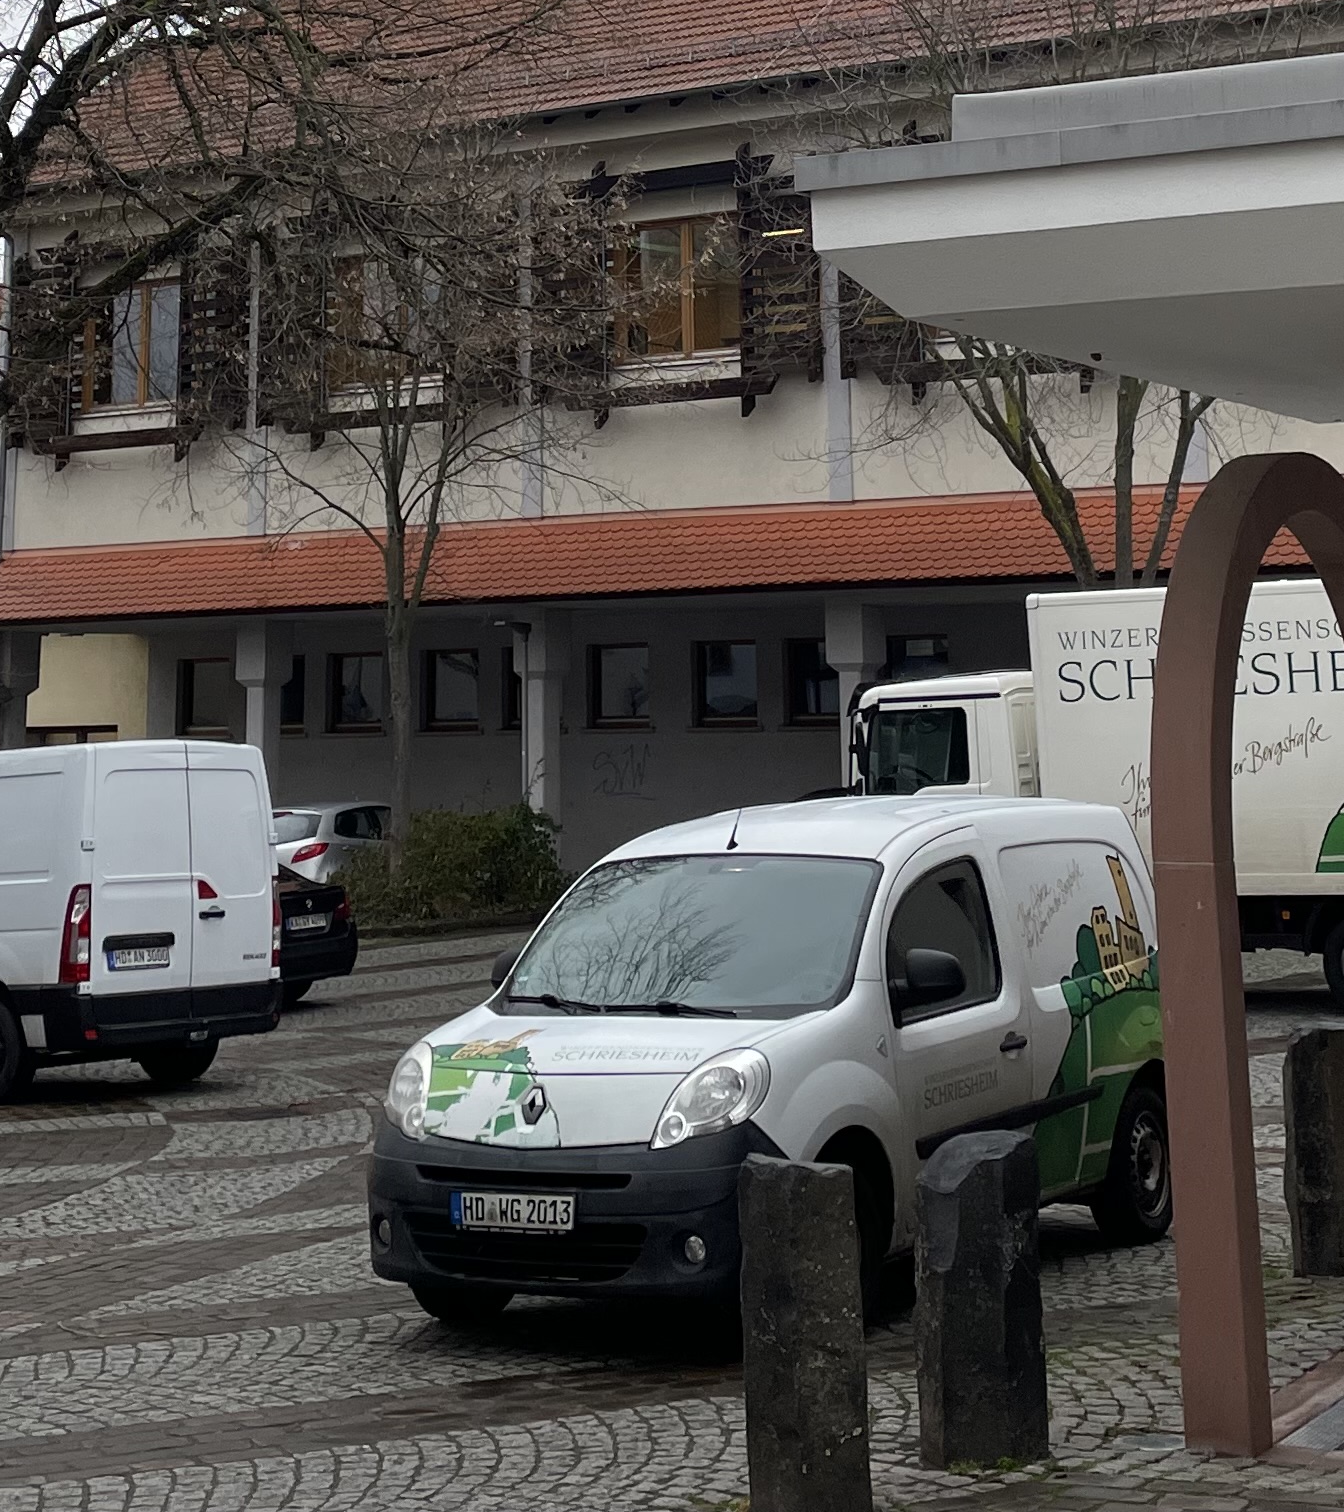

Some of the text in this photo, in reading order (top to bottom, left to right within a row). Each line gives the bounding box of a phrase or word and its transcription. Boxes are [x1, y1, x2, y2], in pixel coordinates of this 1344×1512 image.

[1245, 717, 1332, 774] Bergstraße
[552, 1051, 701, 1062] SCHRIESHEIM
[923, 1069, 999, 1109] SCHRIESHEIM
[463, 1196, 572, 1225] HD WG 2013
